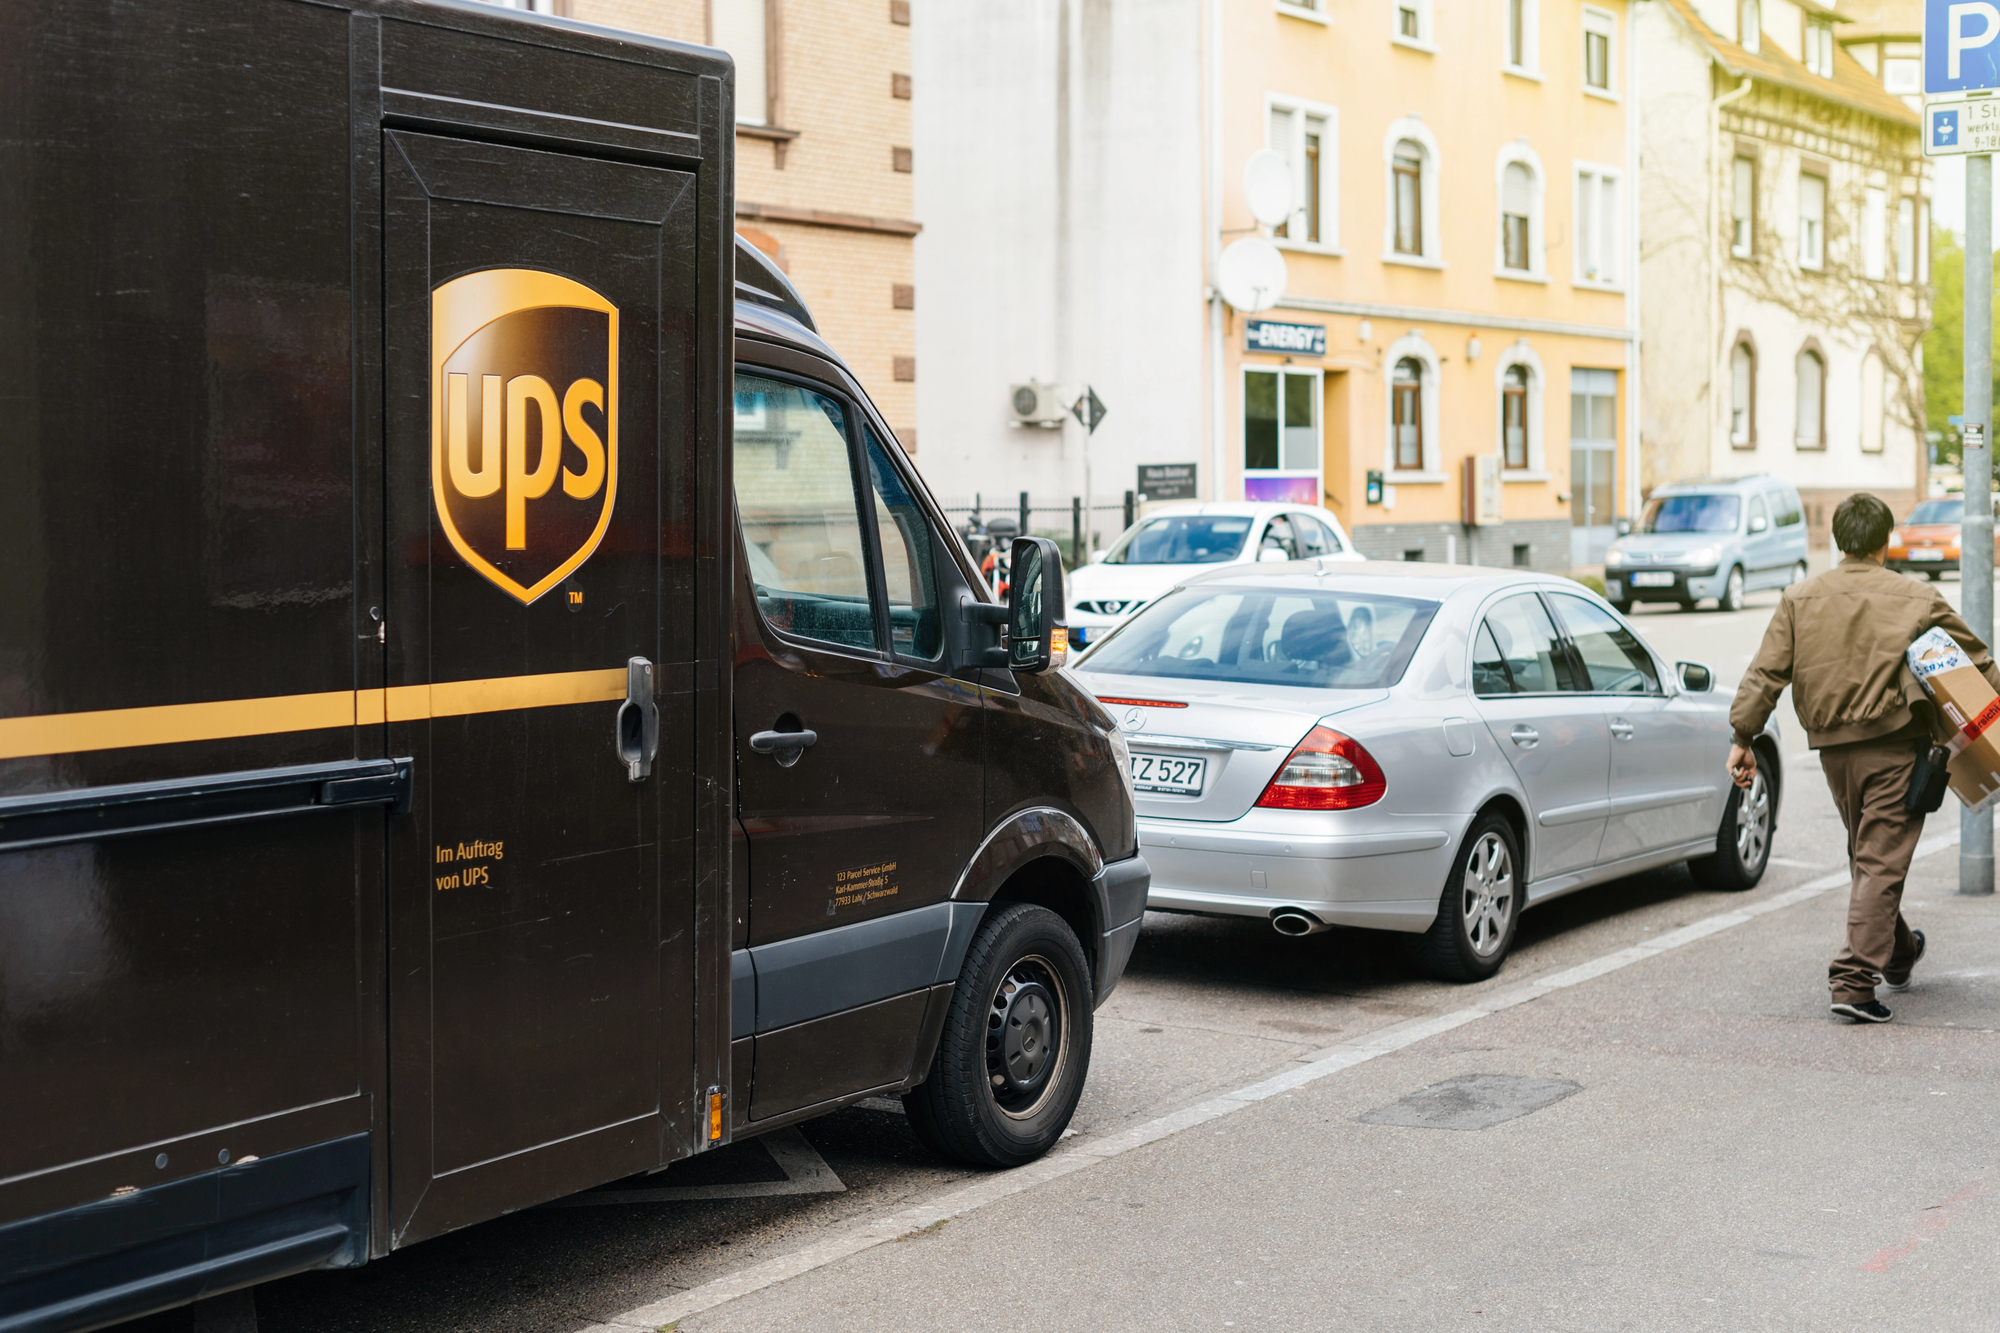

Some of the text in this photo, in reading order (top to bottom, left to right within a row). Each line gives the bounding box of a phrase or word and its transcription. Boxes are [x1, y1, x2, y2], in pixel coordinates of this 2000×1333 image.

[1948, 2, 2000, 79] P
[1968, 104, 2000, 120] 1 St
[1975, 135, 2000, 148] 9-18
[1258, 322, 1315, 350] ENERGY
[448, 372, 606, 550] ups
[568, 591, 583, 604] TM
[1158, 759, 1201, 785] 527
[436, 840, 503, 864] Im Auftrag
[435, 865, 489, 891] von UPS
[837, 861, 897, 882] 123 Parcel Service GmbH
[835, 875, 889, 895] Karl-Kammer-Straße 5
[835, 895, 851, 907] 77933
